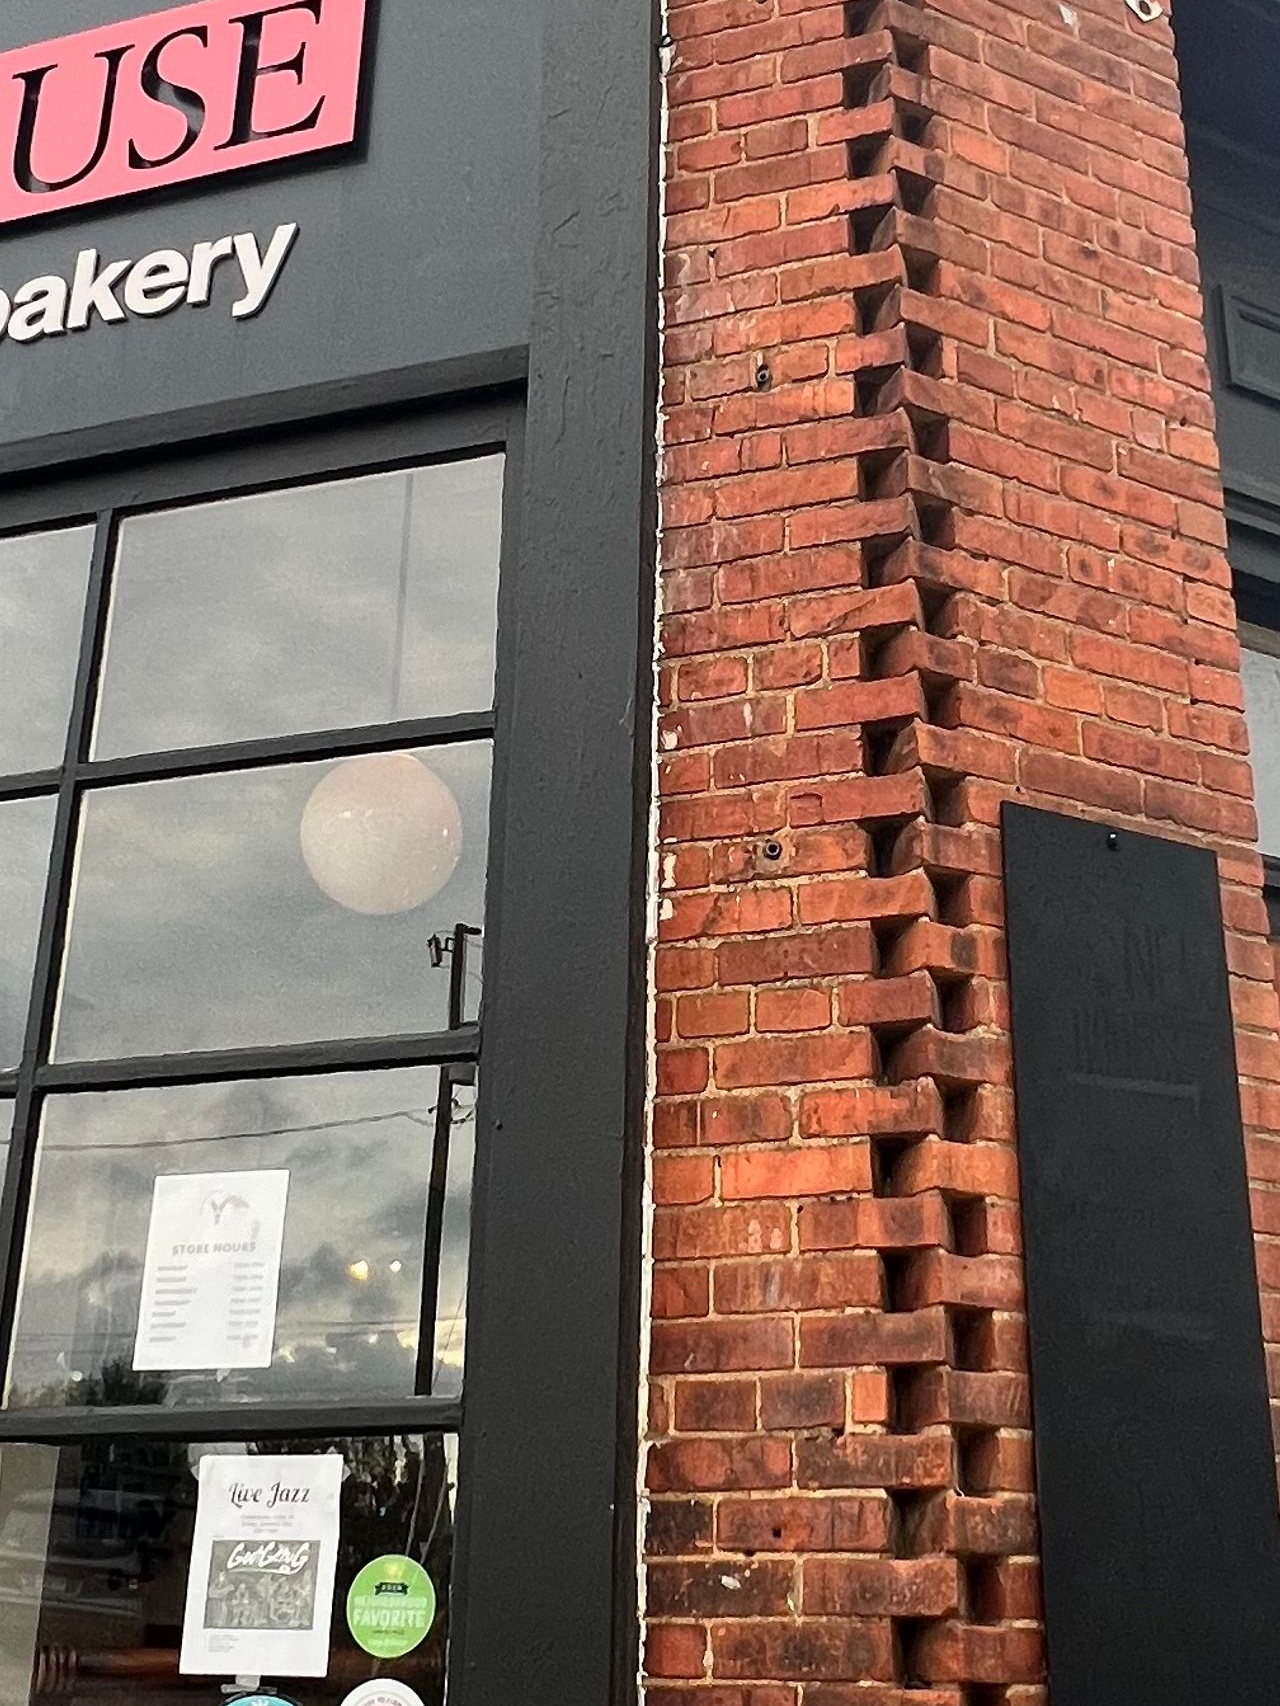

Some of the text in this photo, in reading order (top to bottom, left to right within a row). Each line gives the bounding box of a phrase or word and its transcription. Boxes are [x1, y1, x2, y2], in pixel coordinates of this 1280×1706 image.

[172, 1242, 257, 1256] STORE HOURS
[228, 1481, 311, 1509] Live Jazz
[352, 1608, 426, 1628] FAVORITE
